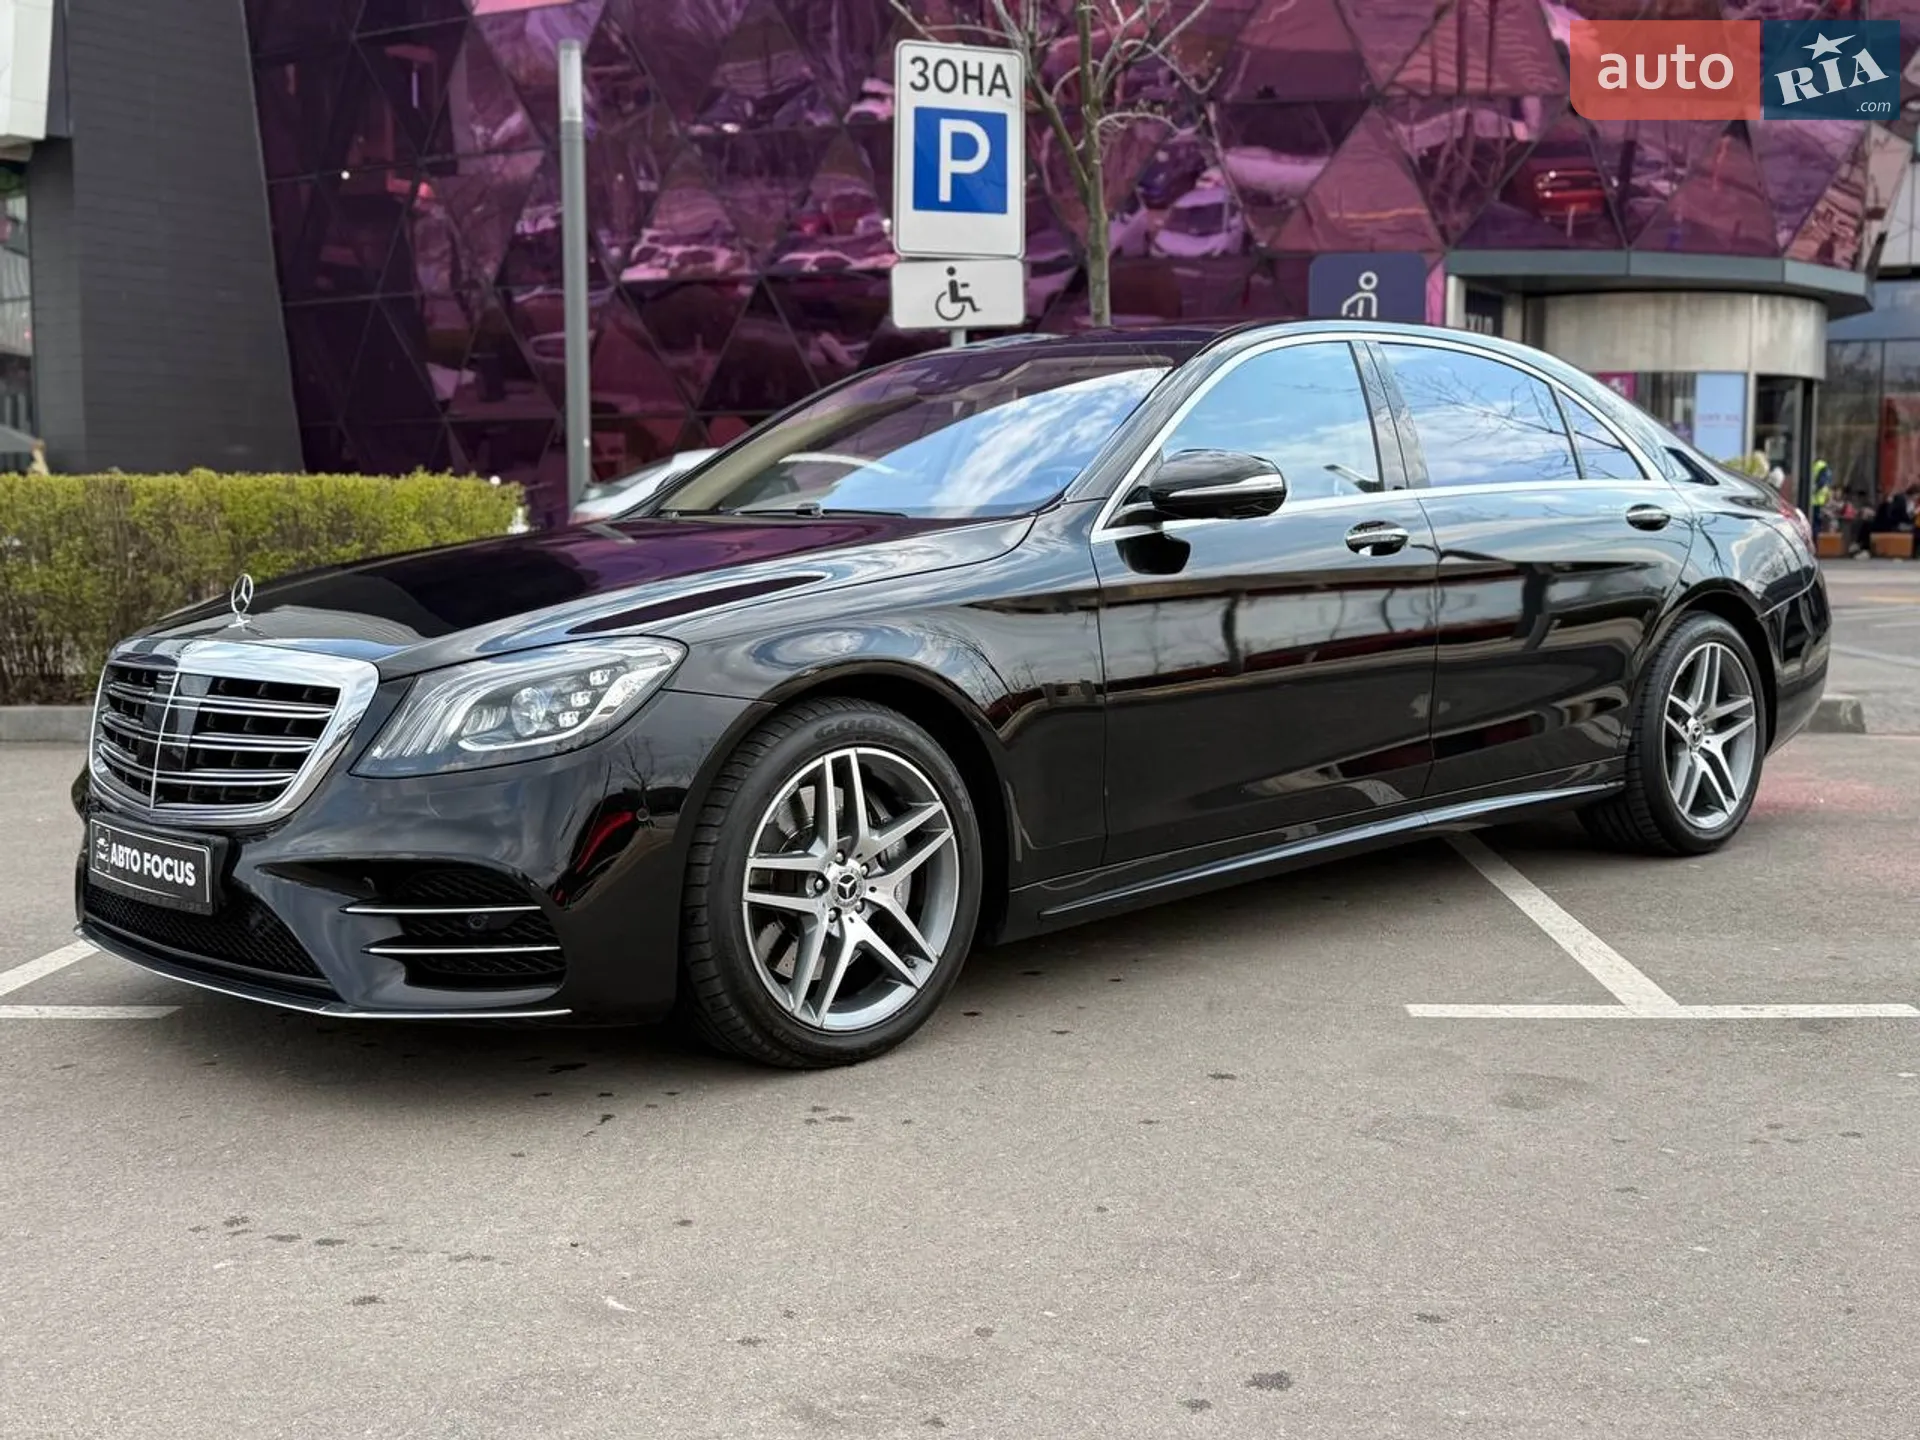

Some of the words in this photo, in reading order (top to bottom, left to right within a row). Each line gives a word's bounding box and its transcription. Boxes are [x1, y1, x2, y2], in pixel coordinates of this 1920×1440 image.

[909, 56, 1012, 98] ЗОНА
[938, 118, 990, 203] P
[144, 852, 196, 886] FOCUS
